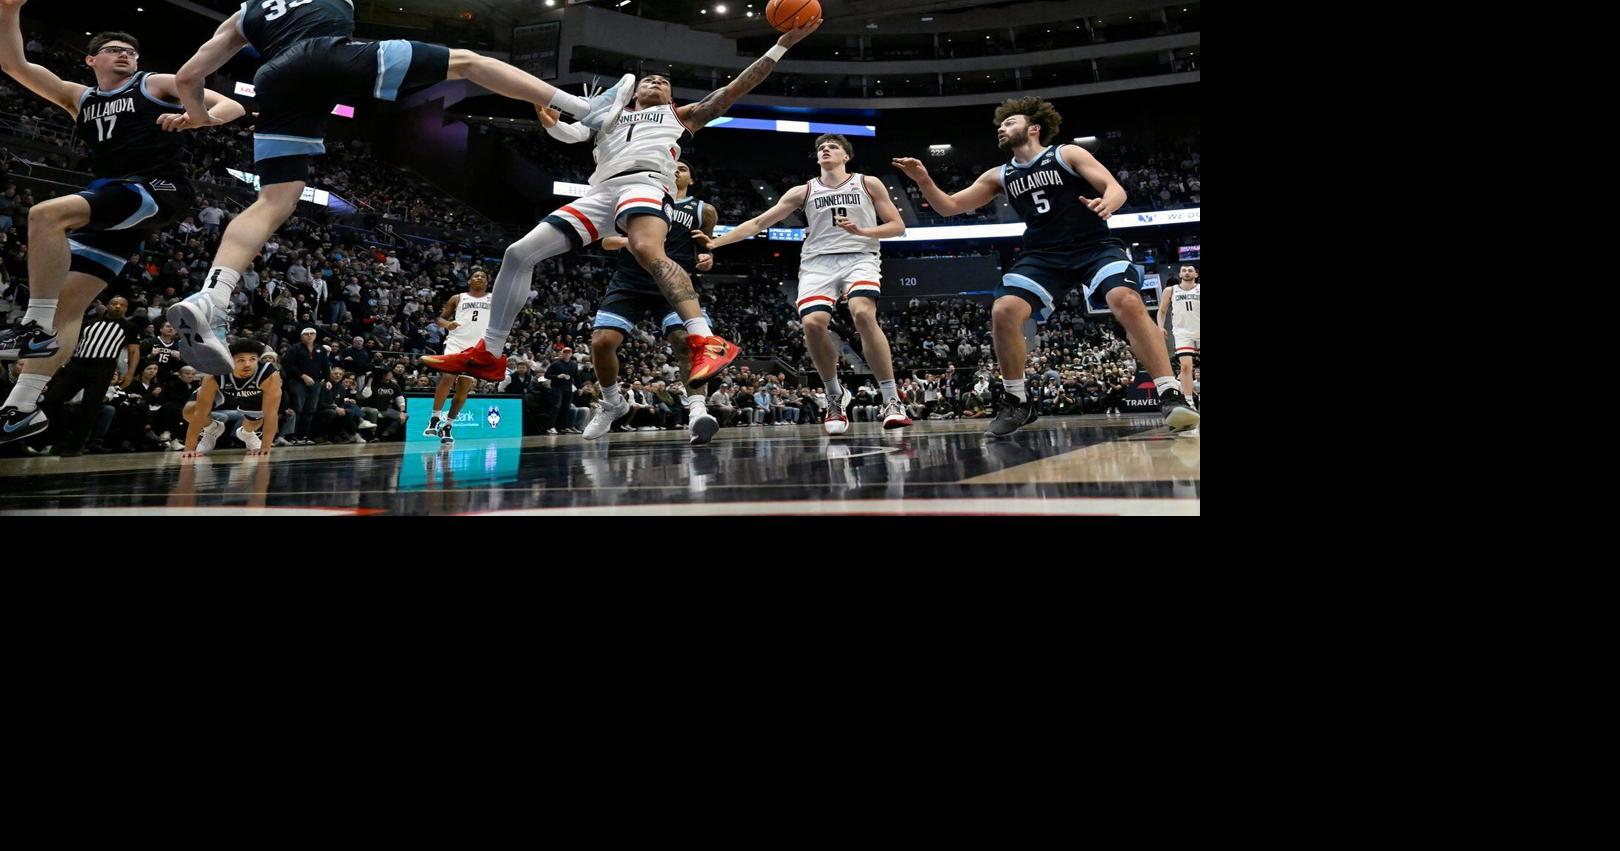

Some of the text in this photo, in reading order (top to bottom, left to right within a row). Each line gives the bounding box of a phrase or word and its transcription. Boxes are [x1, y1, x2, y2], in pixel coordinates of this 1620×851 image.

[95, 114, 117, 142] 17
[626, 124, 636, 142] 1
[930, 149, 945, 157] 223
[1008, 170, 1063, 199] VILLANOVA
[814, 193, 861, 209] CONNECTICUT
[1031, 190, 1051, 214] 5
[900, 277, 917, 286] 120
[1185, 301, 1193, 311] 11
[471, 310, 479, 322] 2
[158, 354, 170, 363] 15
[1125, 398, 1161, 406] TRAVEL
